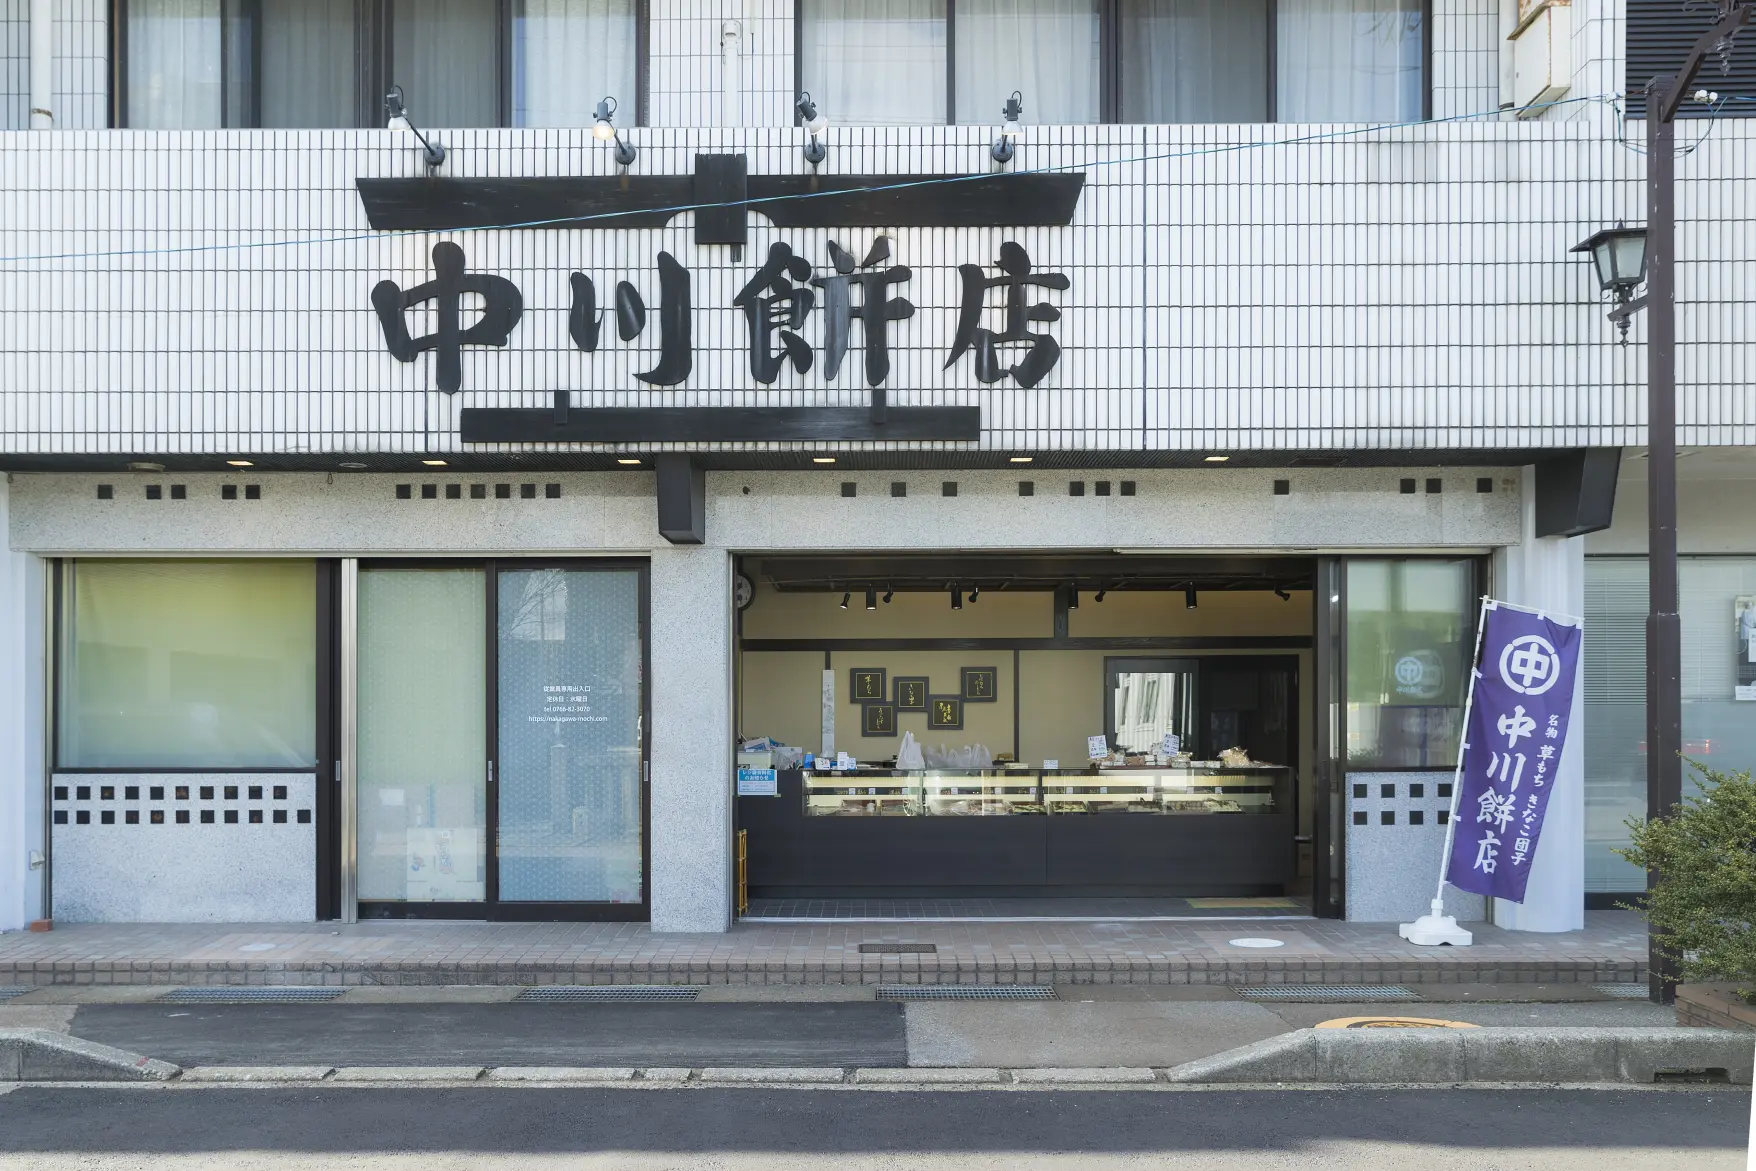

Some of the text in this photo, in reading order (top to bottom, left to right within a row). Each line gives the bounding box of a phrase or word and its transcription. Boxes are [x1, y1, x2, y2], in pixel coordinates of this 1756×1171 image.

[370, 234, 1071, 395] 中川餅店
[1510, 642, 1550, 687] 中
[1473, 704, 1537, 875] 中川餅店
[1510, 714, 1559, 866] 名物 草もち きなこ団子
